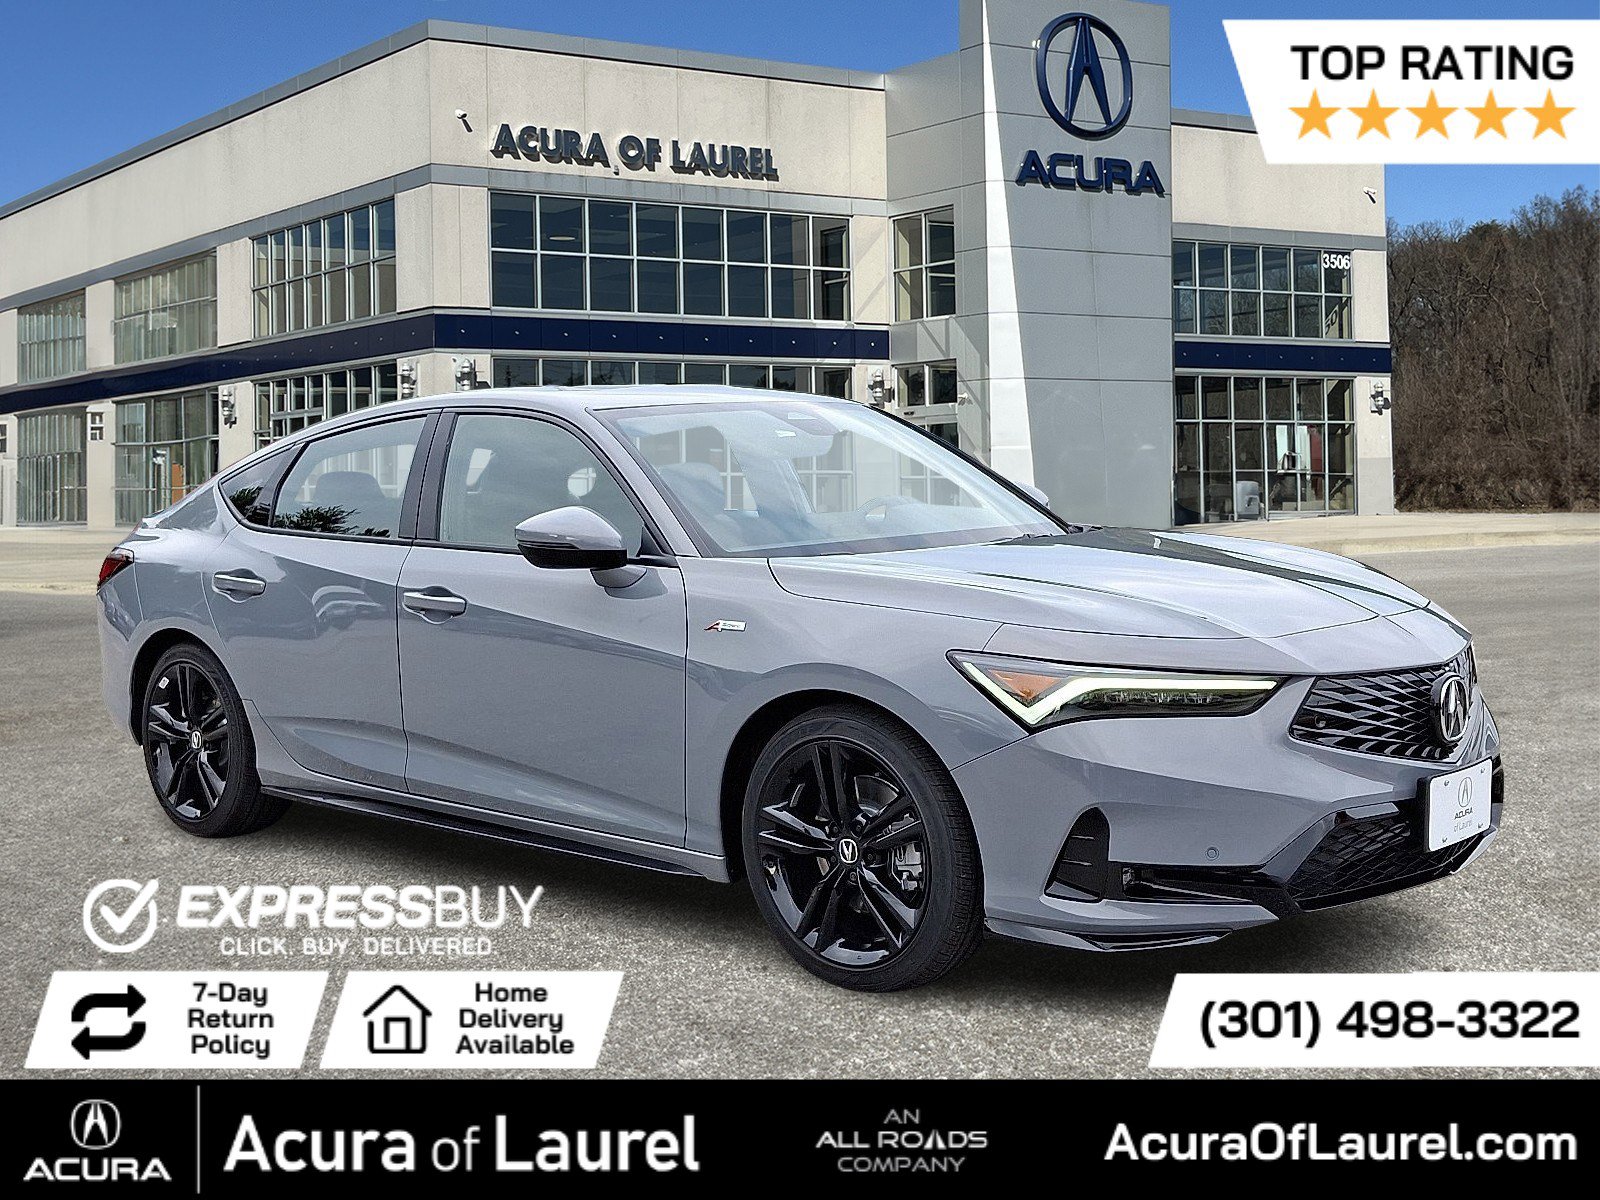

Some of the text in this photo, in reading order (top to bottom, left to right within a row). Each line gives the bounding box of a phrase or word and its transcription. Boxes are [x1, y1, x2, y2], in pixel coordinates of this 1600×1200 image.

[490, 122, 779, 182] ACURA OF LAUREL
[1015, 149, 1166, 198] ACURA
[1322, 253, 1351, 270] 3506
[1454, 807, 1473, 820] ACURA
